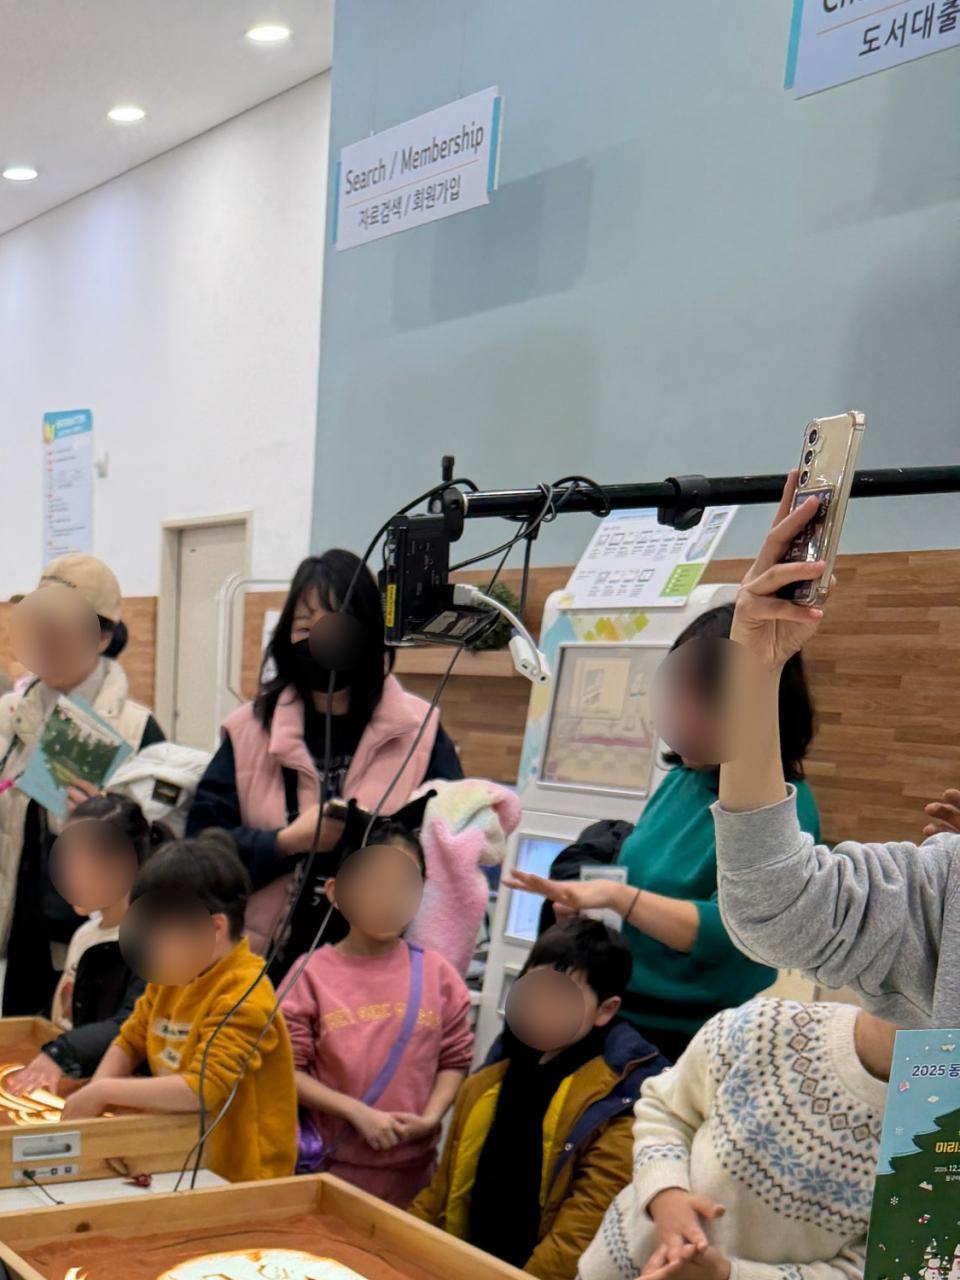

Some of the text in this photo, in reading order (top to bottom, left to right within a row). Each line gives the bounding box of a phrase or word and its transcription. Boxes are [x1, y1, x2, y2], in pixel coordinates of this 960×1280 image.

[345, 121, 484, 195] Search / Membership
[911, 1064, 946, 1077] 2025
[935, 1141, 960, 1153] 미리
